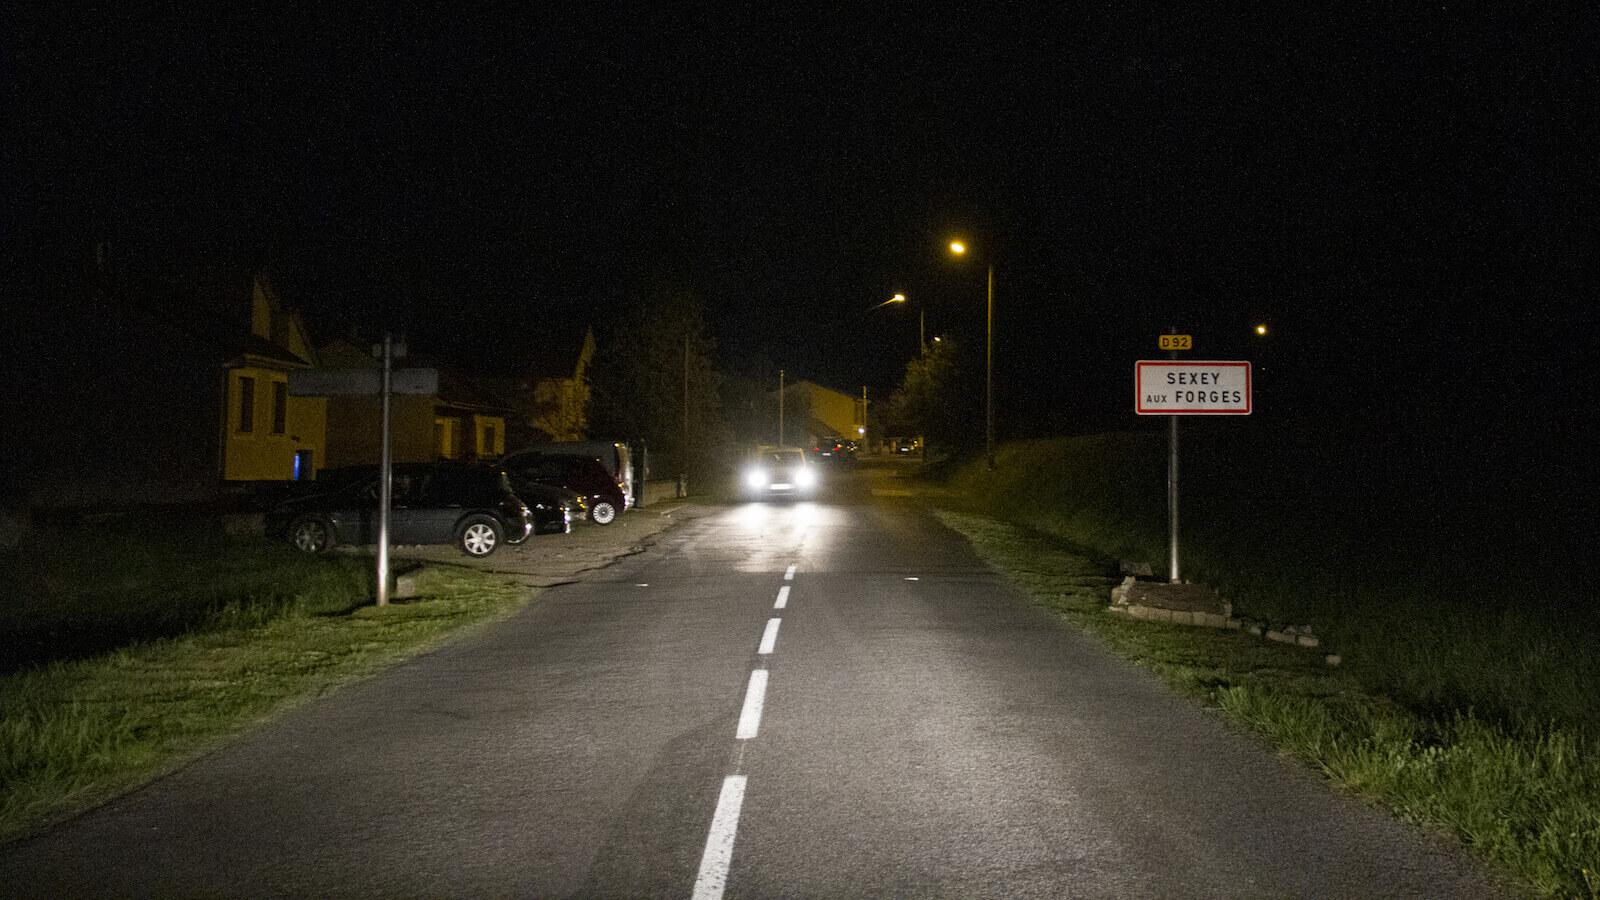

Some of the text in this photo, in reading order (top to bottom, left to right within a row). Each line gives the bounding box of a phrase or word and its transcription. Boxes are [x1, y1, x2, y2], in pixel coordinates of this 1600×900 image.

[1167, 372, 1220, 385] SEXEY
[1146, 391, 1241, 403] AUX FORGES
